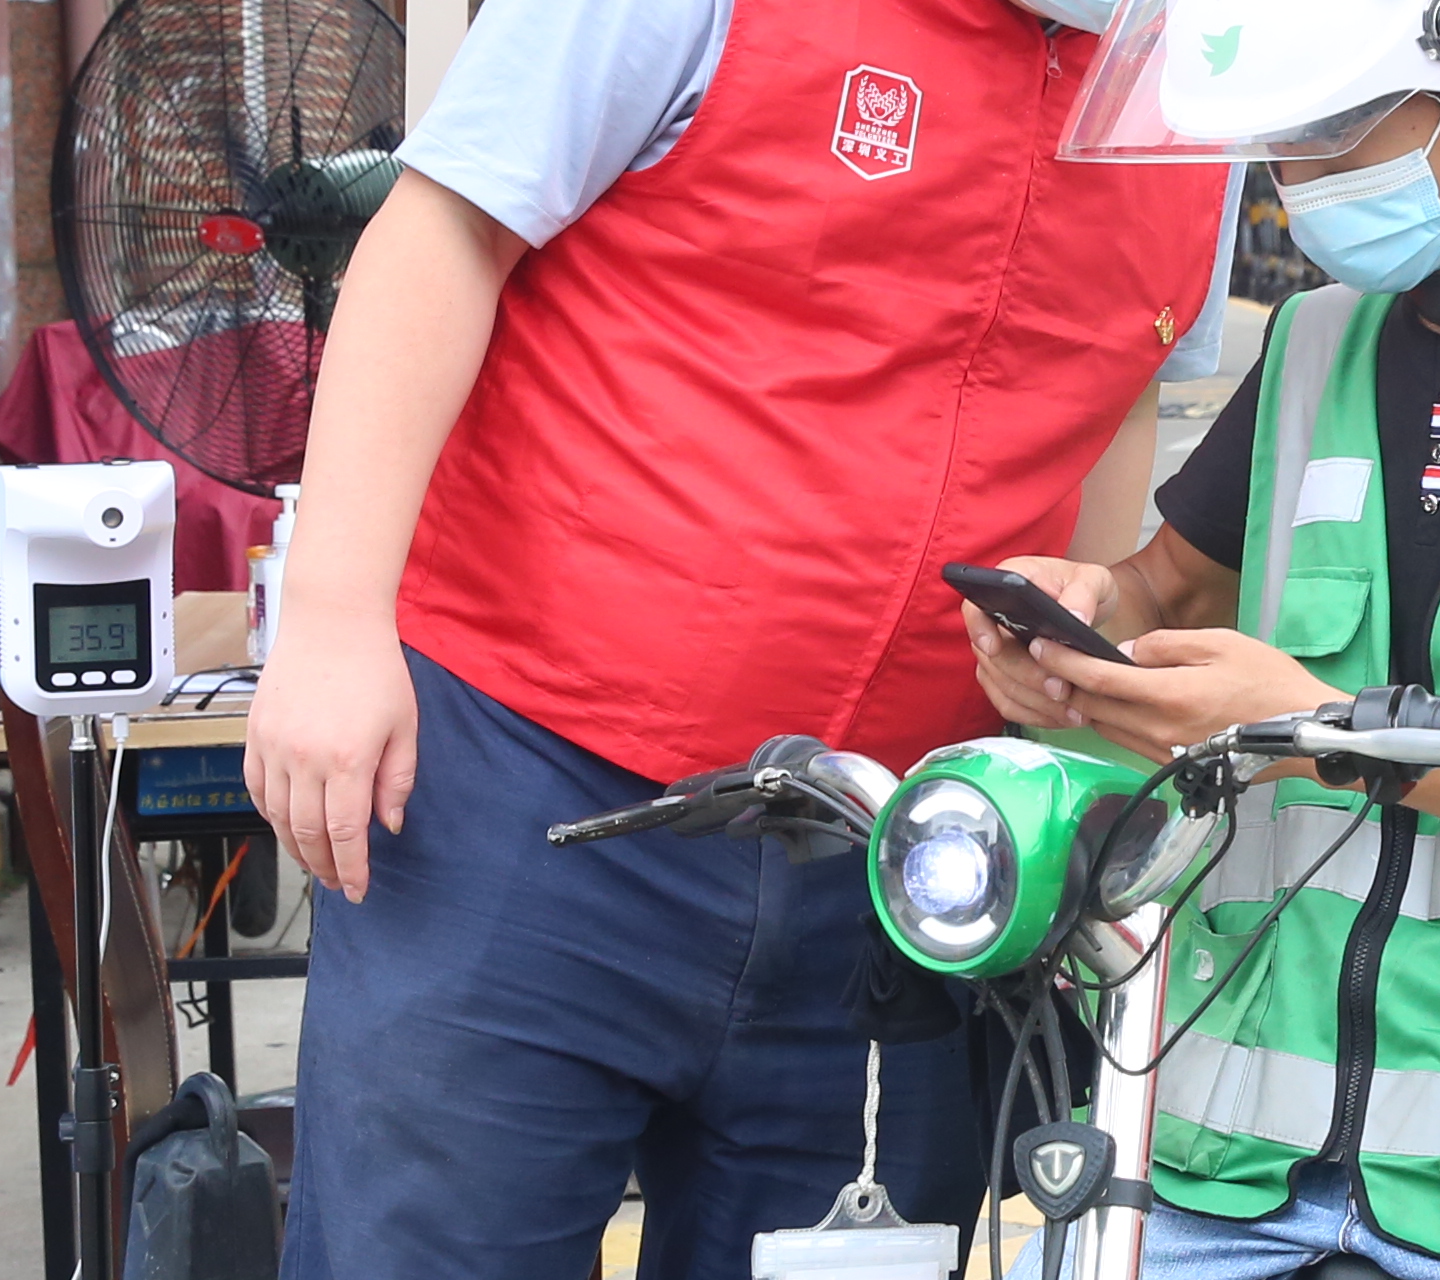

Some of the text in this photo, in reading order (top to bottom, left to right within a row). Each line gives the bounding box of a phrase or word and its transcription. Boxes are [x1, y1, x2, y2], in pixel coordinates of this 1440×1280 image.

[841, 138, 904, 166] 深圳义工
[68, 623, 125, 652] 35.9
